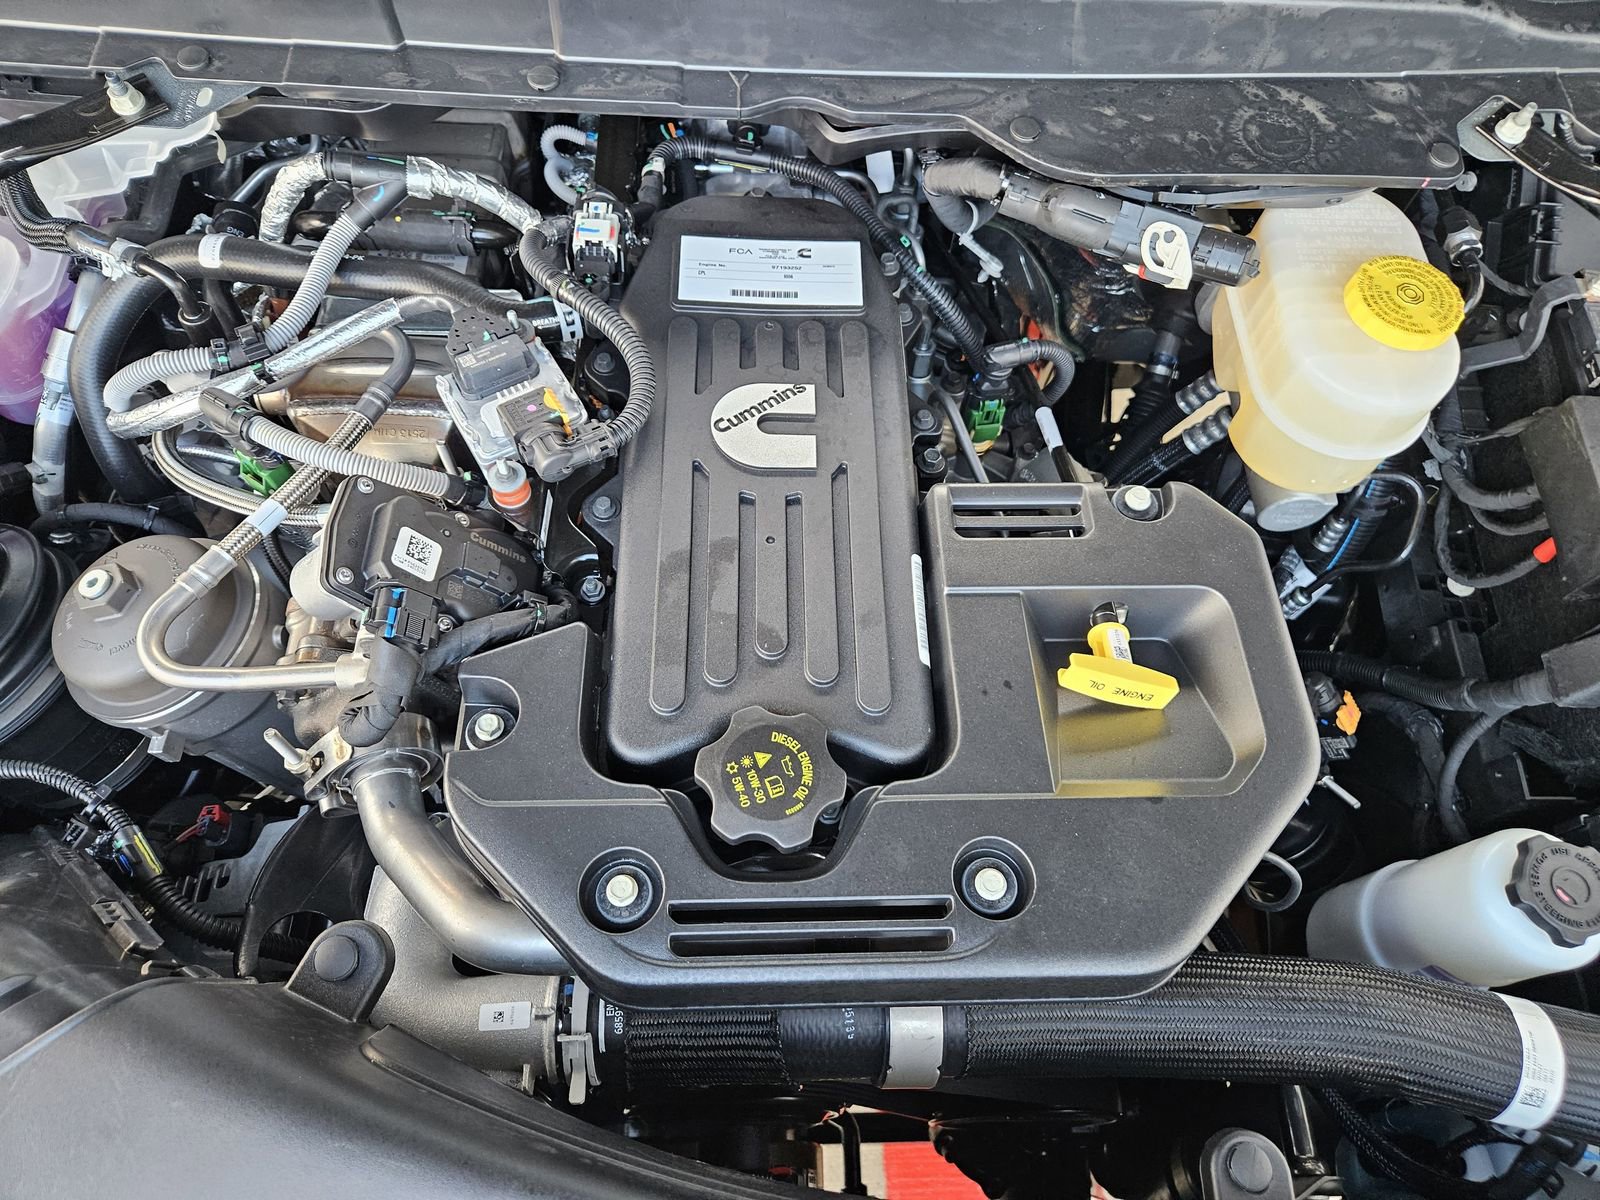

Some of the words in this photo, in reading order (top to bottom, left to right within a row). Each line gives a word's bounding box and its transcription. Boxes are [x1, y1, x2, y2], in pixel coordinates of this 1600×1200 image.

[713, 383, 807, 433] Cummins
[470, 531, 527, 564] Cummins
[1088, 679, 1106, 691] OIL
[1112, 687, 1154, 701] ENGINE
[770, 730, 802, 755] DIESEL
[797, 750, 814, 787] ENGINE
[731, 776, 751, 808] 5W-40
[746, 768, 767, 804] 10W-30
[792, 785, 809, 801] OIL
[614, 1006, 624, 1035] 6859
